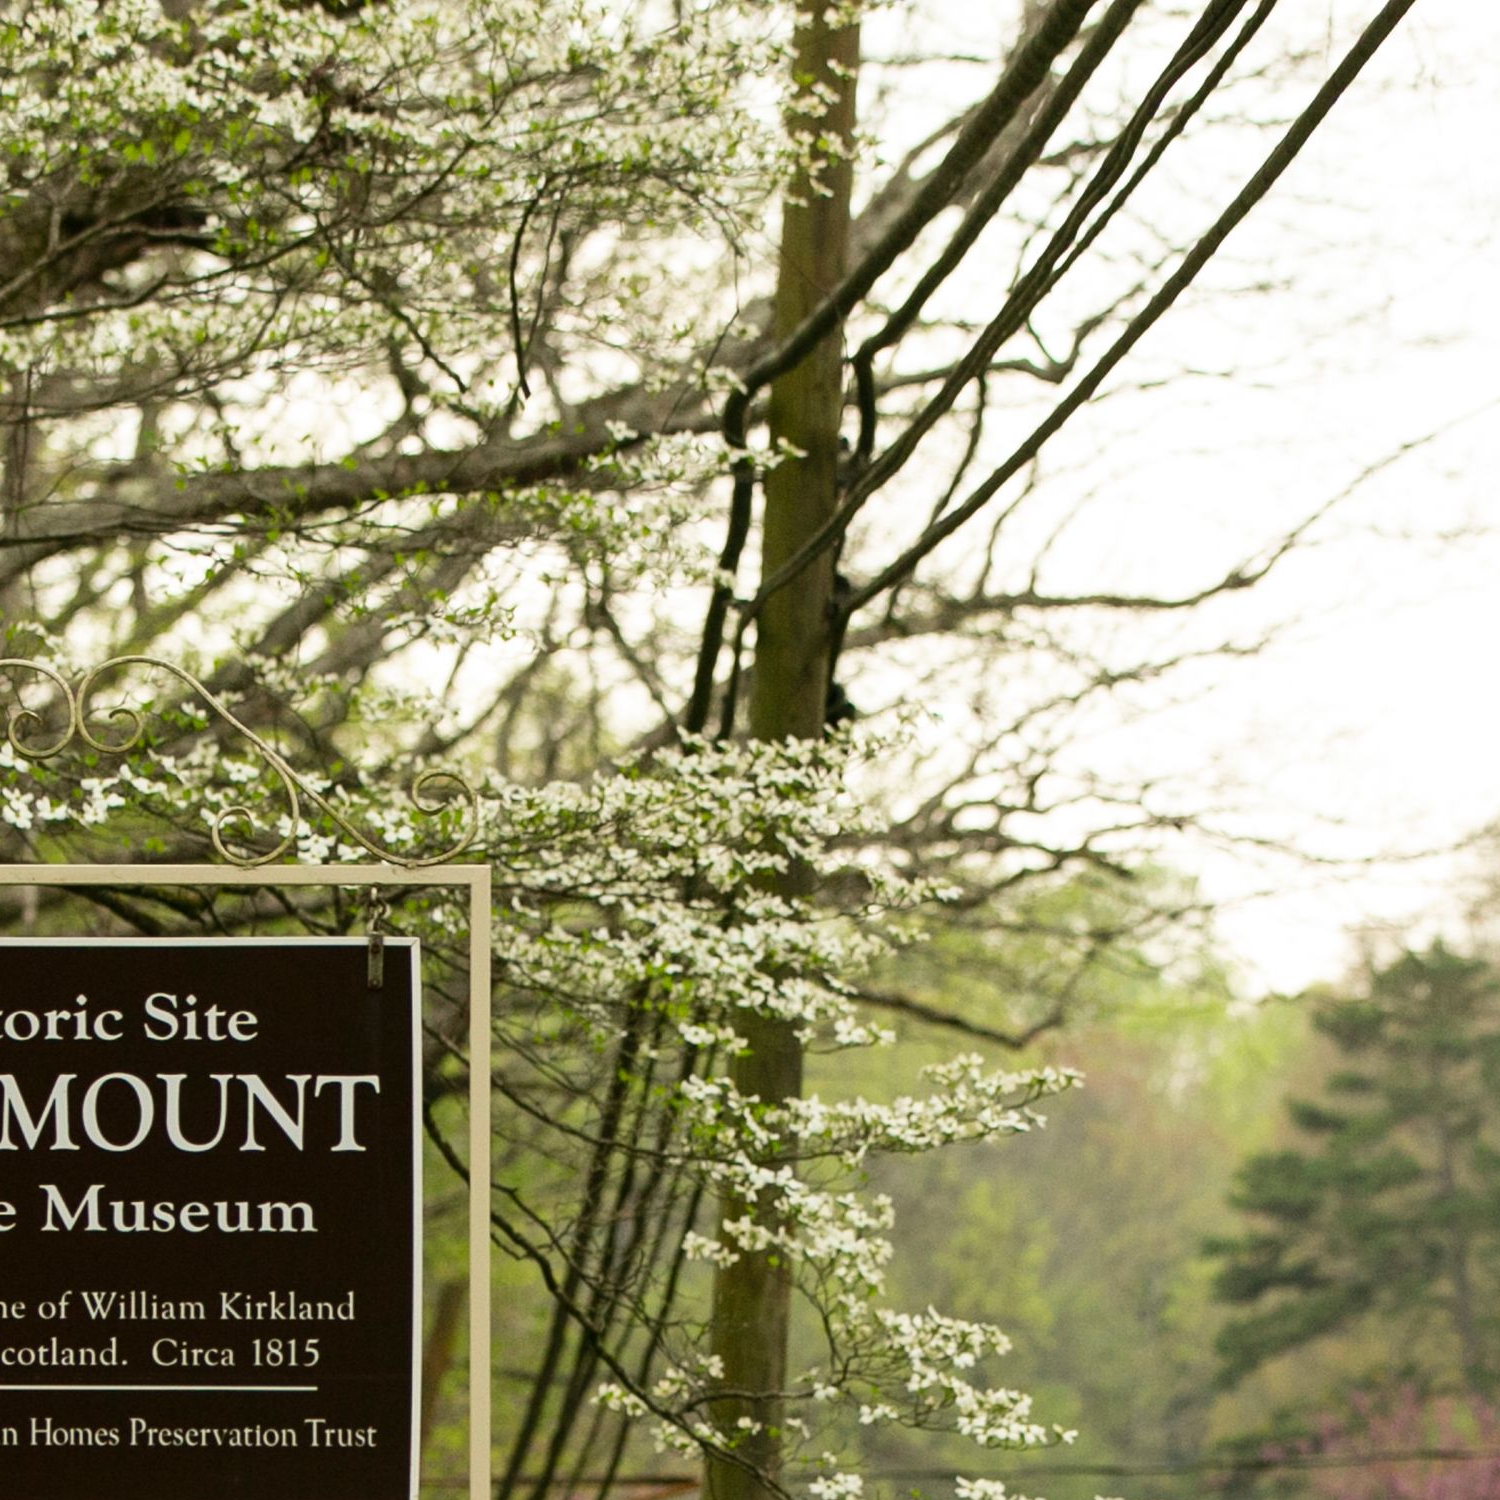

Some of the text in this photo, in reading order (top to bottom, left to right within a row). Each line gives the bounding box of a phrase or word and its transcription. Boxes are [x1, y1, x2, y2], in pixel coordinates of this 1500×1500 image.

[143, 992, 259, 1042] Site
[38, 1184, 319, 1233] Museum
[37, 1290, 73, 1320] of
[80, 1290, 206, 1320] William
[219, 1290, 355, 1321] Kirkland
[151, 1337, 235, 1367] Circa
[252, 1338, 320, 1367] 1815
[30, 1417, 120, 1447] Homes
[129, 1417, 298, 1447] Preservation
[304, 1418, 377, 1448] Trust
